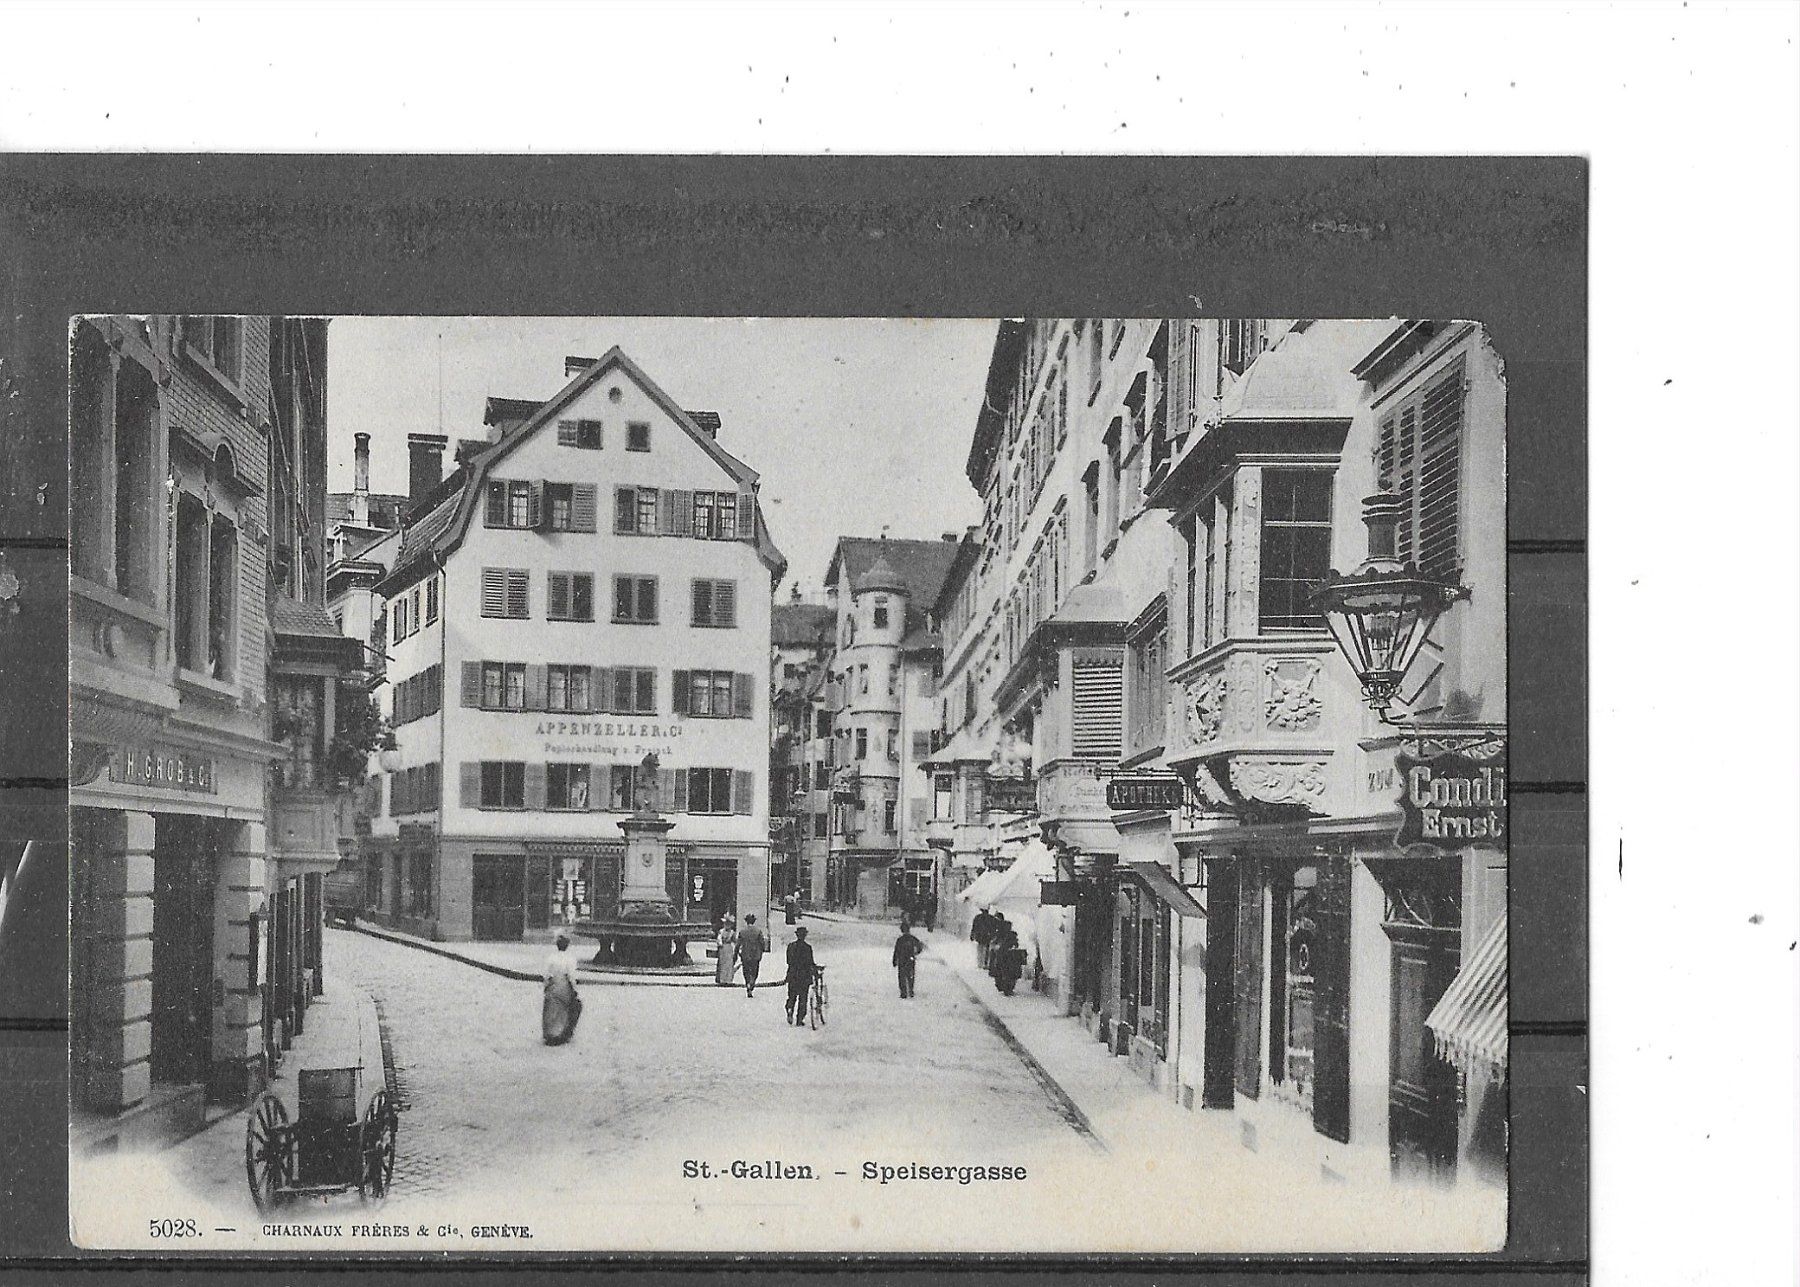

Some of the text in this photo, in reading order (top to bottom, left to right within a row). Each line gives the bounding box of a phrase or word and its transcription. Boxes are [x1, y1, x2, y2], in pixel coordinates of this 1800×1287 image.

[535, 721, 661, 738] APPENZELLER
[1408, 765, 1507, 808] Condi
[1421, 808, 1504, 838] Ernst
